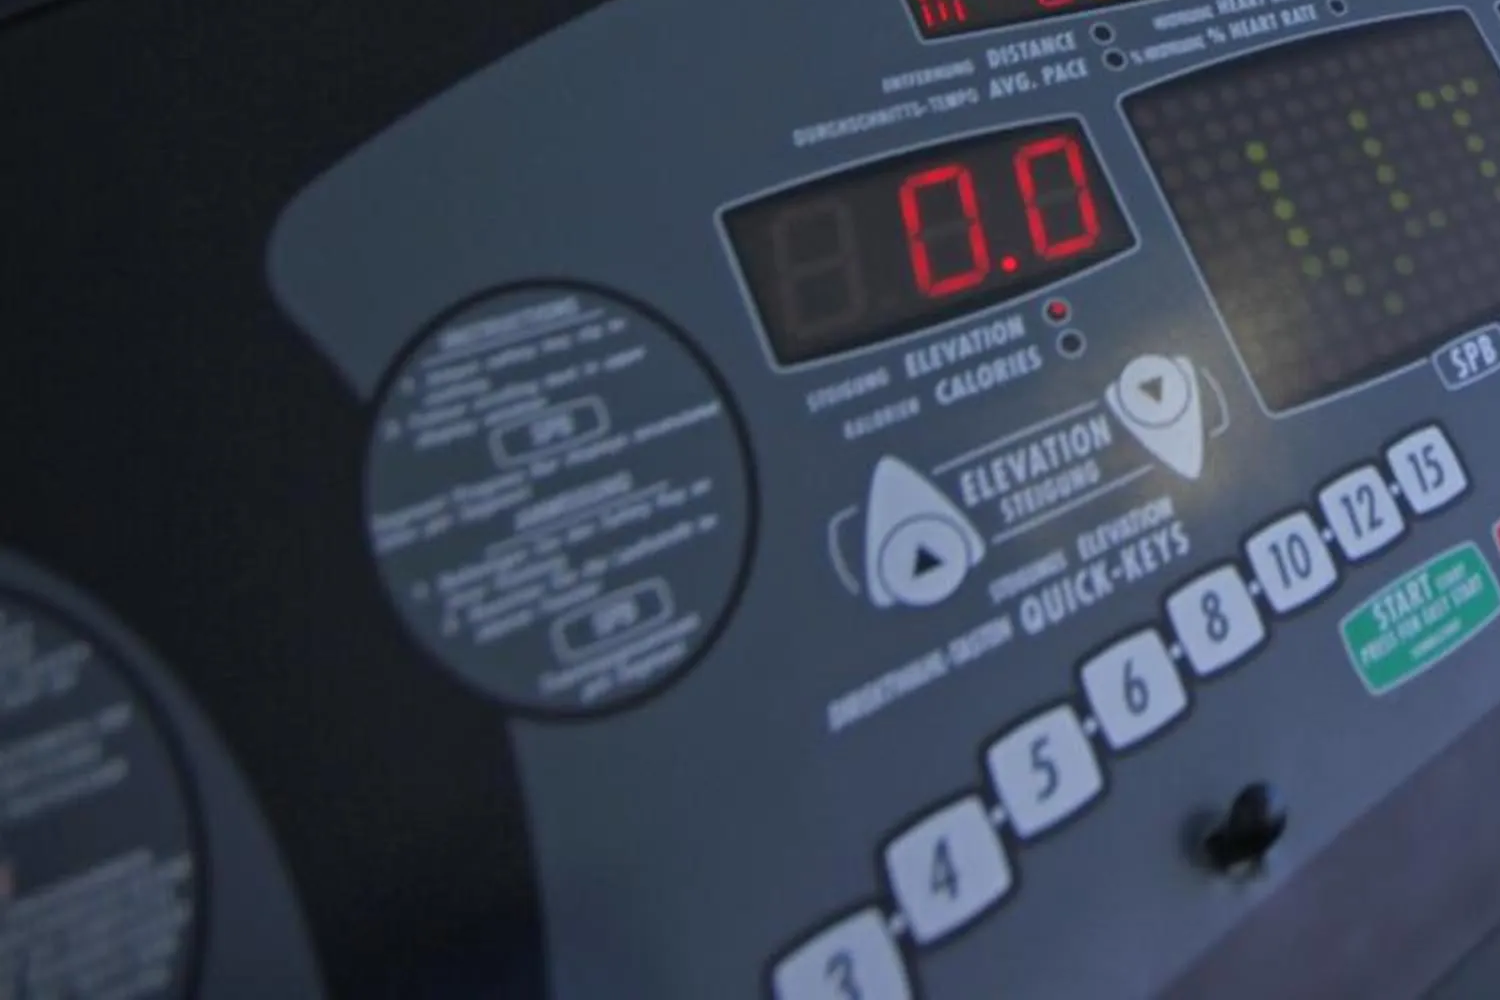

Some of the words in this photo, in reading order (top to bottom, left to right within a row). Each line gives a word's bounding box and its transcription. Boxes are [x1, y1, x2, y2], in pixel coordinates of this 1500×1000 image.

[986, 30, 1076, 69] DISTANCE
[1228, 13, 1278, 39] HEART
[1280, 4, 1318, 27] RATE
[989, 68, 1038, 99] AVG.
[1041, 57, 1089, 87] PACE
[900, 134, 1099, 297] 0.0
[905, 314, 1026, 379] ELEVATION
[935, 345, 1042, 406] CALORIES
[960, 414, 1113, 507] ELEVATION
[1408, 444, 1445, 495] 15
[1077, 496, 1174, 561] ELEVATION
[1341, 484, 1383, 539] 12
[1019, 522, 1191, 635] QUICK-KEYS
[1268, 533, 1313, 590] 10
[1202, 590, 1229, 643] 8
[1373, 573, 1432, 631] START
[1122, 657, 1150, 717] 6
[1029, 734, 1061, 804] 5
[928, 834, 960, 901] 4
